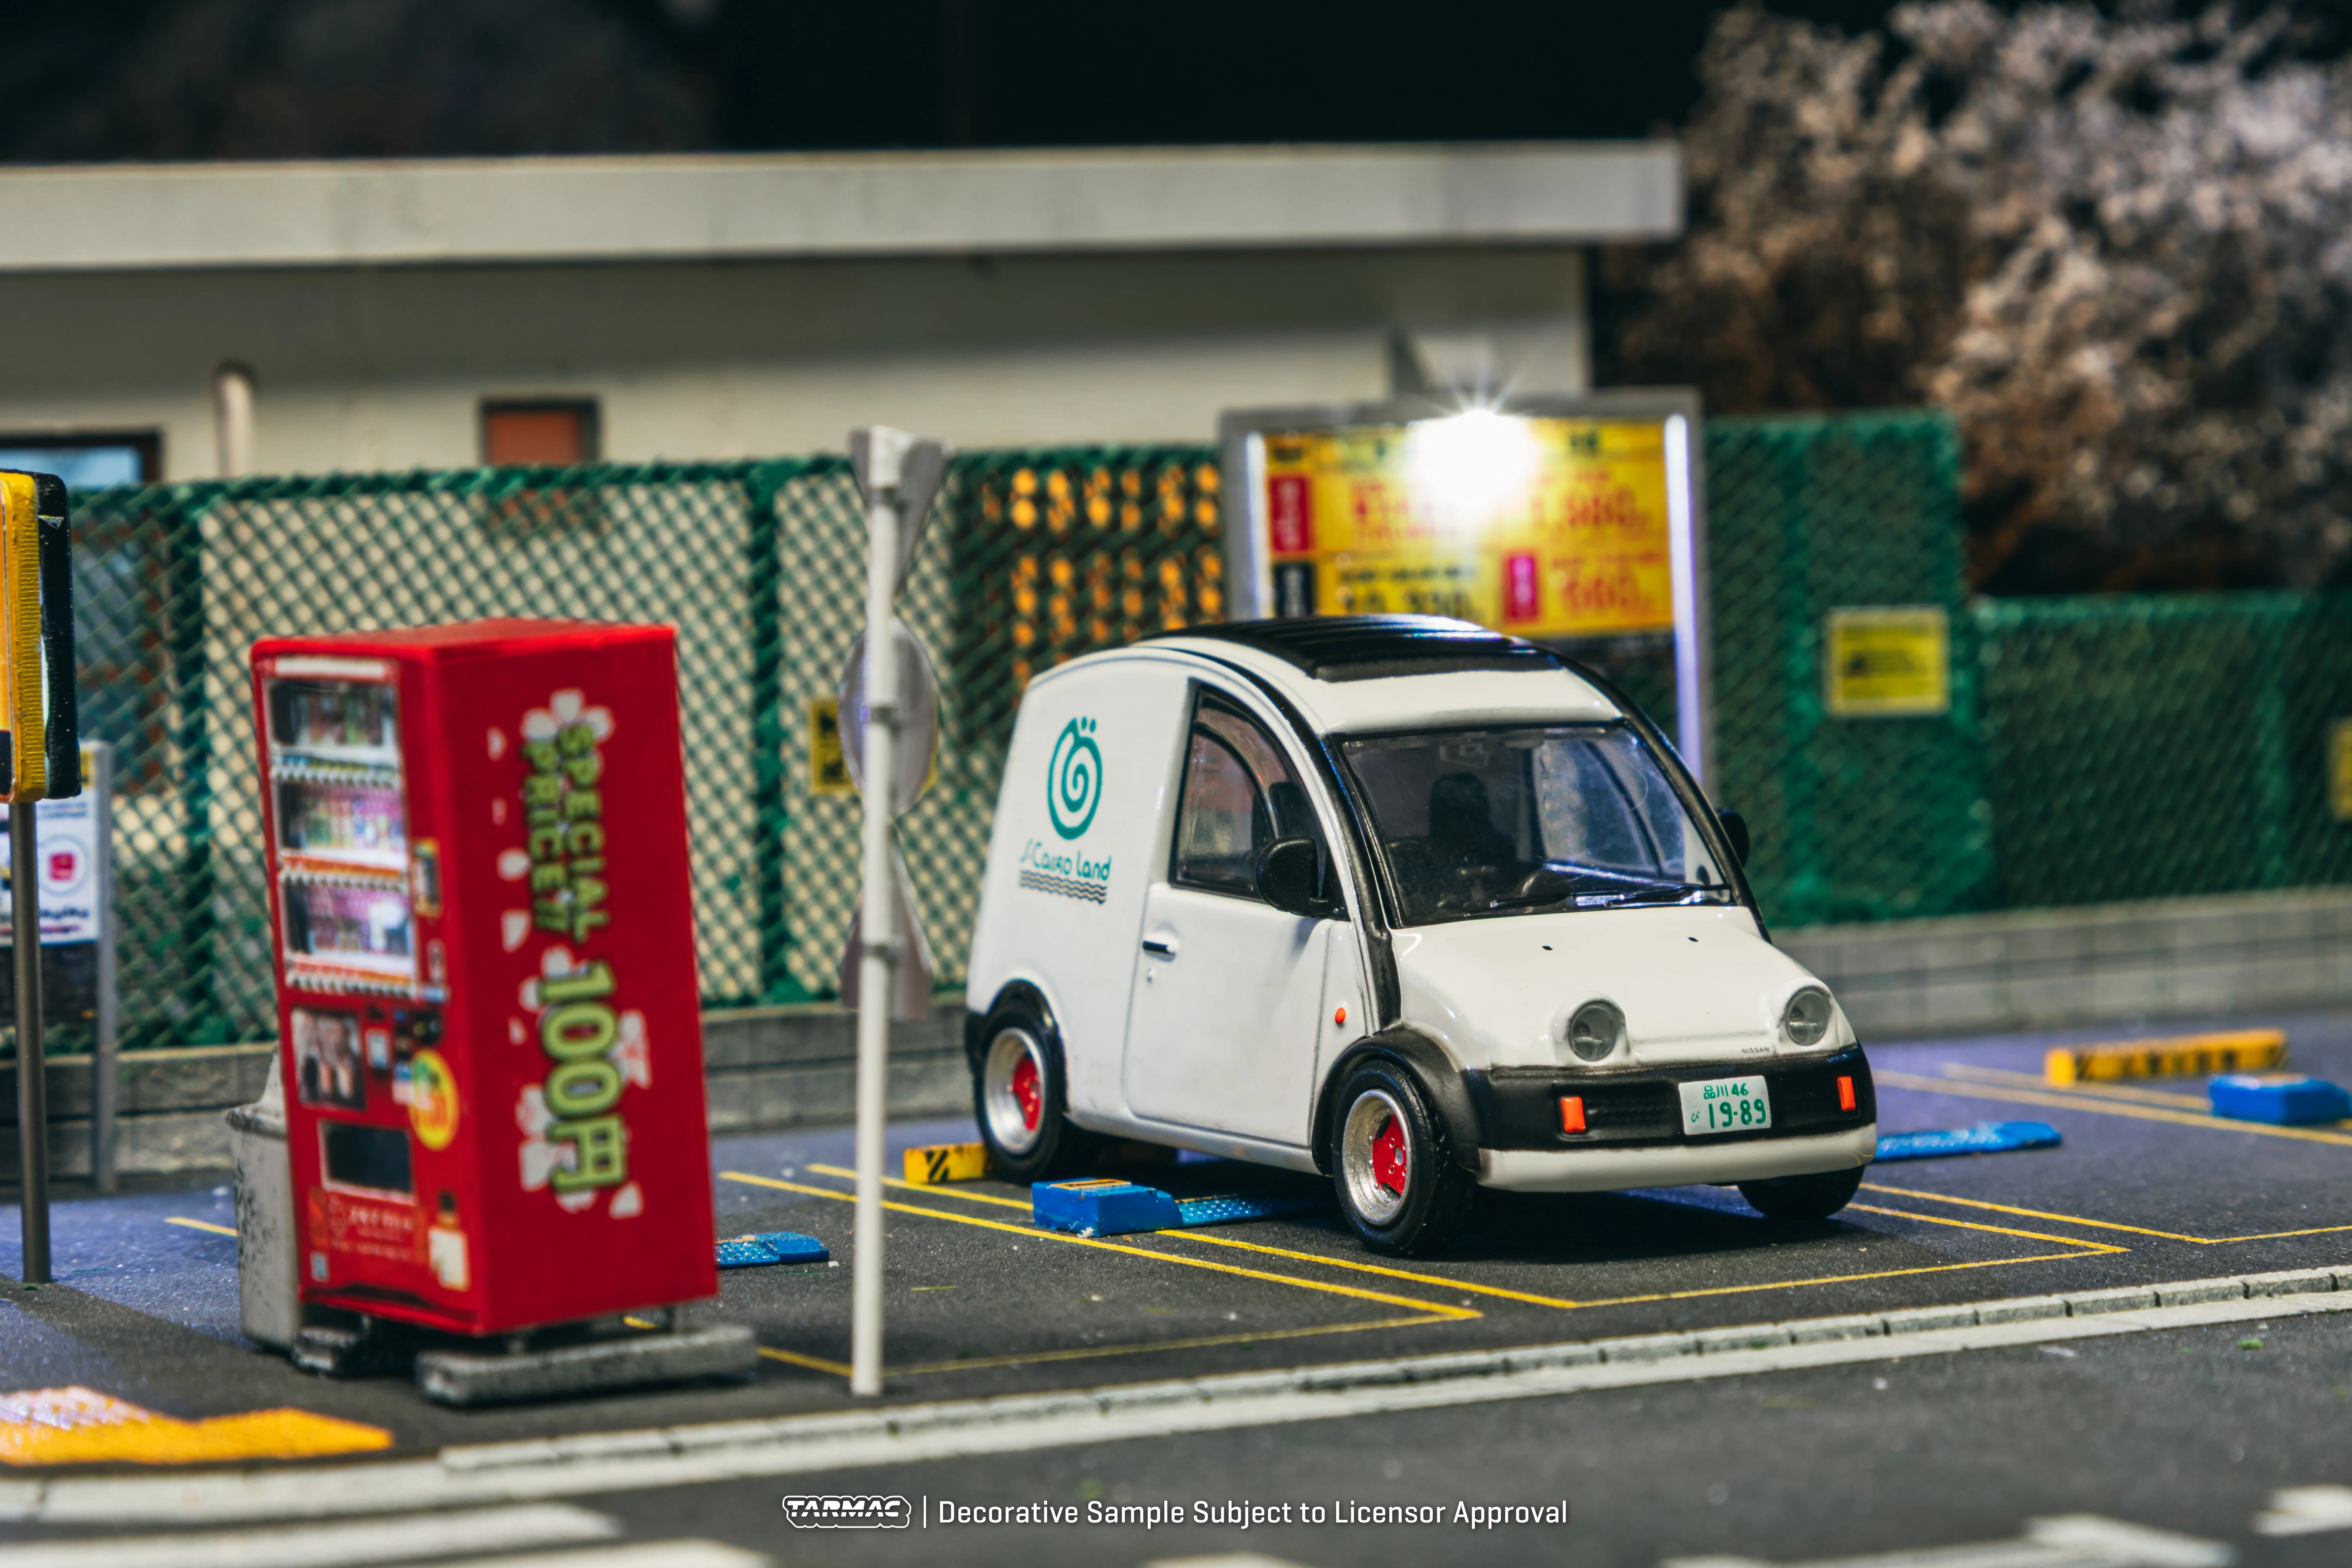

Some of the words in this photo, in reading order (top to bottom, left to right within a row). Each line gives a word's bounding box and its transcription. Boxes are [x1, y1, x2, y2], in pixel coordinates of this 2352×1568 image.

[558, 725, 608, 944] SPECIAL
[538, 959, 623, 1192] 100円
[1703, 1085, 1728, 1100] 品川
[1731, 1083, 1749, 1097] 46
